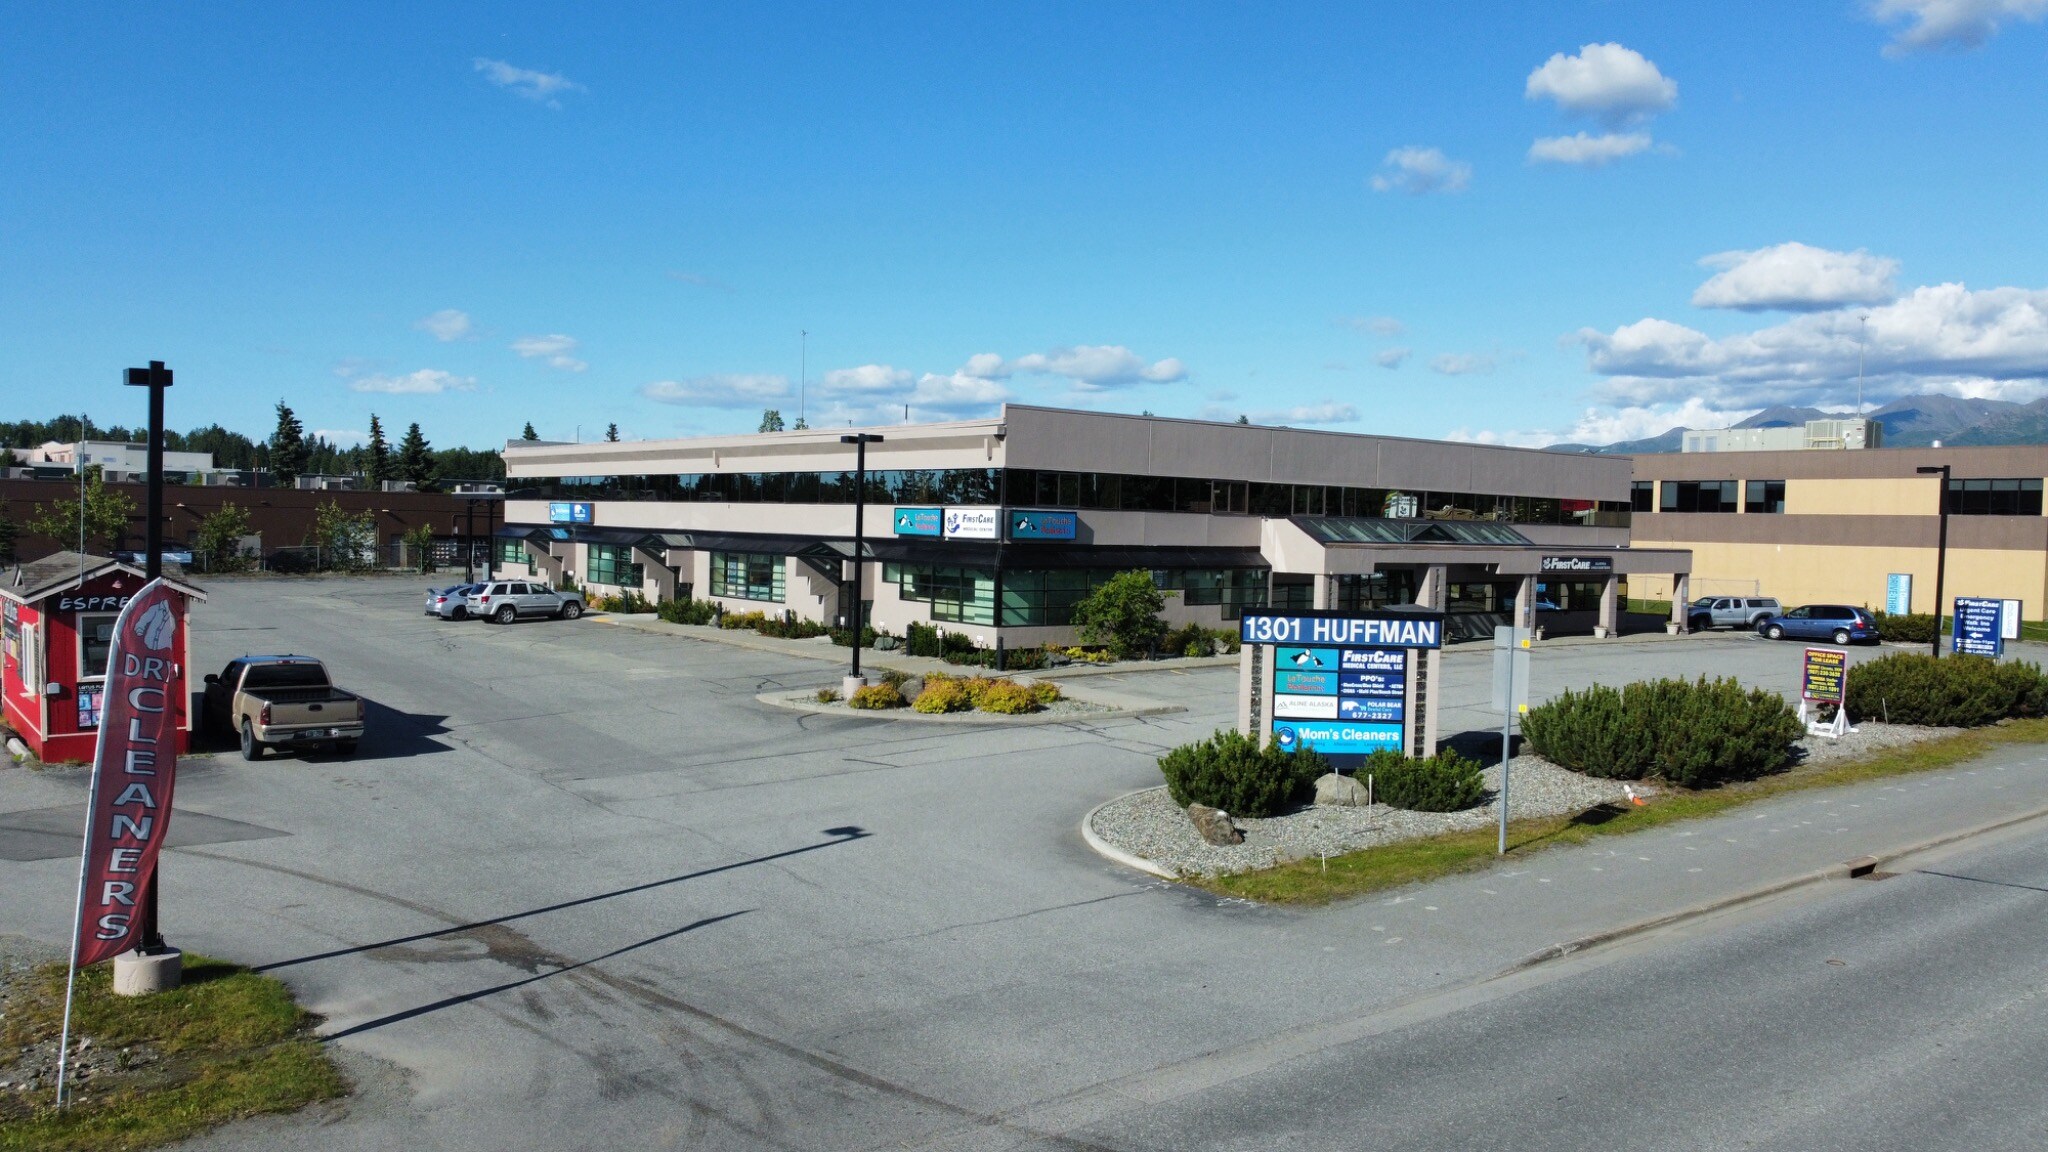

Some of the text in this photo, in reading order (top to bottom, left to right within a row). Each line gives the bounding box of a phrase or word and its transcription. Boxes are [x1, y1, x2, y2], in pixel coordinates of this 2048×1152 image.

[1246, 616, 1435, 644] 1301 HUFFMAN
[1298, 728, 1339, 740] Mom's
[1342, 728, 1400, 741] Cleaners
[96, 687, 164, 940] CLEANERS
